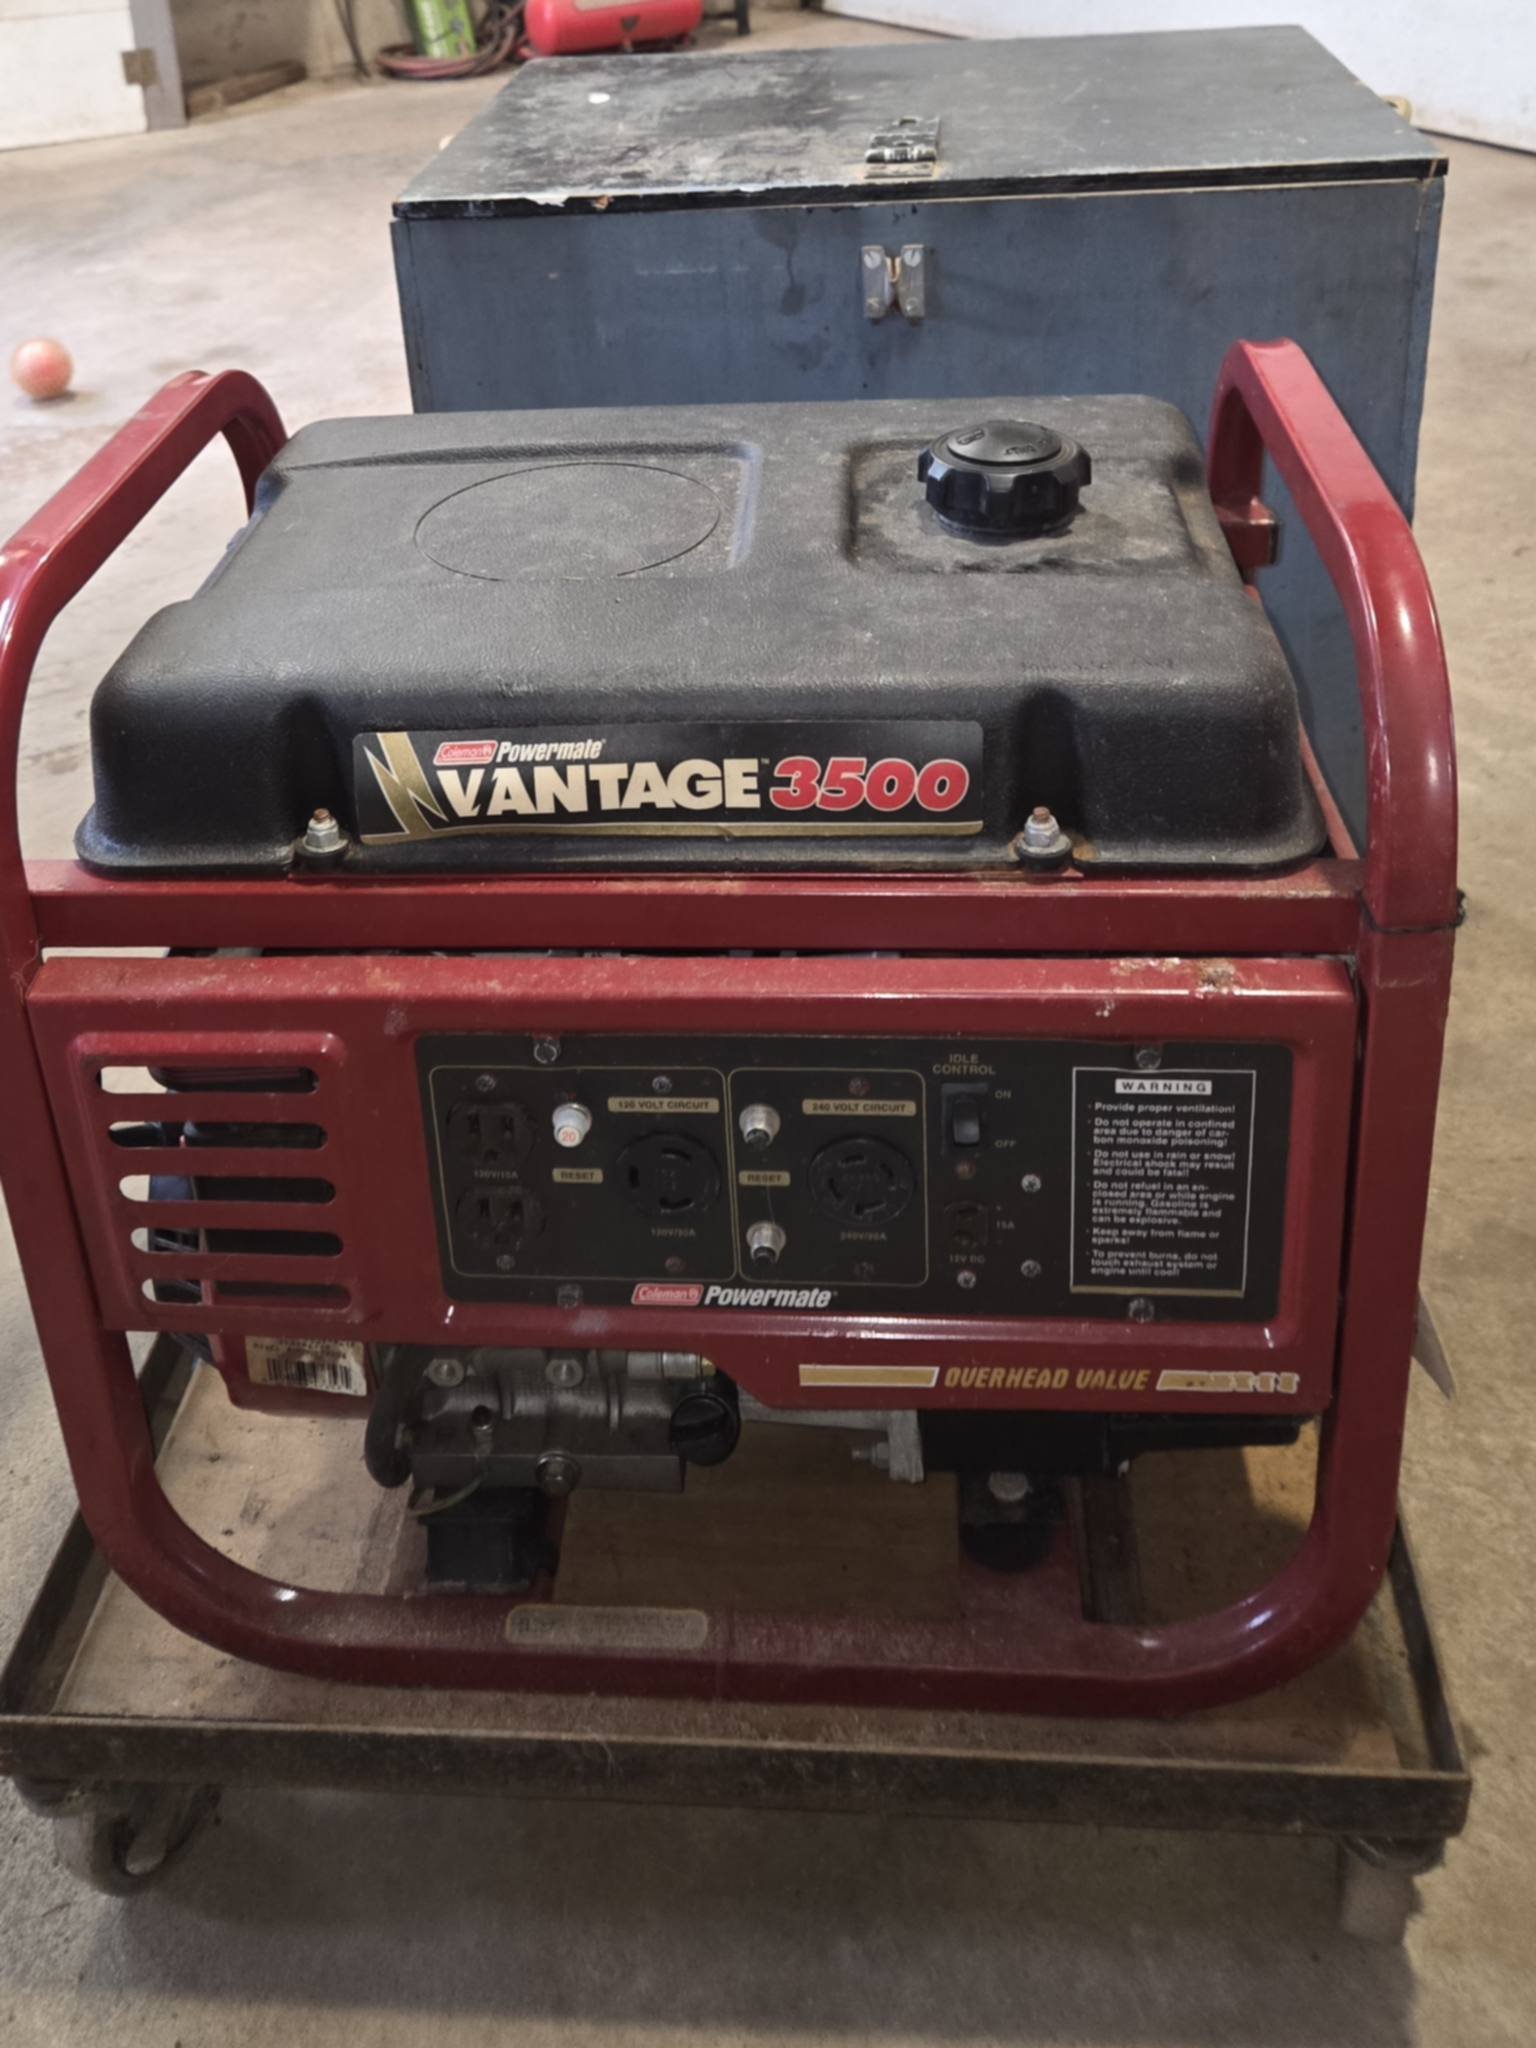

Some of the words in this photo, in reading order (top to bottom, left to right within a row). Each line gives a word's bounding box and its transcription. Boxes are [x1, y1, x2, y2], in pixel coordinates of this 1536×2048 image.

[496, 739, 601, 763] Powermate
[436, 758, 761, 818] VANTAGE
[769, 756, 969, 812] 3500
[950, 1053, 979, 1064] IDLE
[932, 1063, 996, 1075] CONTROL
[1122, 1082, 1207, 1093] WARNING
[995, 1090, 1011, 1100] ON
[639, 1101, 664, 1110] VOLT
[667, 1101, 709, 1111] CIRCUIT
[812, 1103, 830, 1112] 240
[834, 1103, 860, 1112] VOLT
[863, 1103, 906, 1113] CIRCUIT
[1094, 1102, 1135, 1111] Provide
[1138, 1104, 1173, 1114] proper
[1176, 1105, 1235, 1113] ventilation!
[1094, 1118, 1109, 1126] Do
[1112, 1118, 1129, 1126] not
[1132, 1119, 1172, 1129] operate
[1175, 1119, 1185, 1127] in
[1188, 1119, 1235, 1129] confined
[562, 1131, 576, 1142] 20
[1142, 1128, 1152, 1136] to
[1155, 1128, 1191, 1137] danger
[995, 1139, 1016, 1148] OFF
[1093, 1136, 1114, 1144] bon
[1094, 1149, 1109, 1158] Do
[1112, 1150, 1129, 1158] not
[1153, 1151, 1164, 1159] in
[1167, 1151, 1187, 1159] rain
[1093, 1159, 1142, 1167] Electrical
[1145, 1159, 1176, 1168] shock
[1179, 1161, 1201, 1170] may
[1205, 1161, 1234, 1170] result
[560, 1171, 595, 1181] RESET
[1115, 1168, 1144, 1176] could
[1147, 1168, 1160, 1176] be
[747, 1173, 783, 1183] RESET
[1093, 1180, 1108, 1189] Do
[1131, 1181, 1161, 1190] refuel
[1164, 1182, 1173, 1190] in
[1199, 1193, 1235, 1202] engine
[1151, 1199, 1197, 1207] Gasoline
[1092, 1207, 1142, 1216] extremely
[1145, 1208, 1199, 1217] flammable
[1202, 1209, 1222, 1218] and
[1093, 1228, 1119, 1236] Keep
[1122, 1229, 1148, 1238] away
[1150, 1229, 1175, 1237] from
[1177, 1230, 1206, 1238] flame
[1093, 1249, 1105, 1257] To
[1107, 1251, 1146, 1259] prevent
[1184, 1252, 1198, 1260] do
[1166, 1261, 1204, 1270] system
[1091, 1268, 1126, 1276] engine
[704, 1285, 832, 1308] Powermate
[944, 1366, 1069, 1389] OVERHEAD
